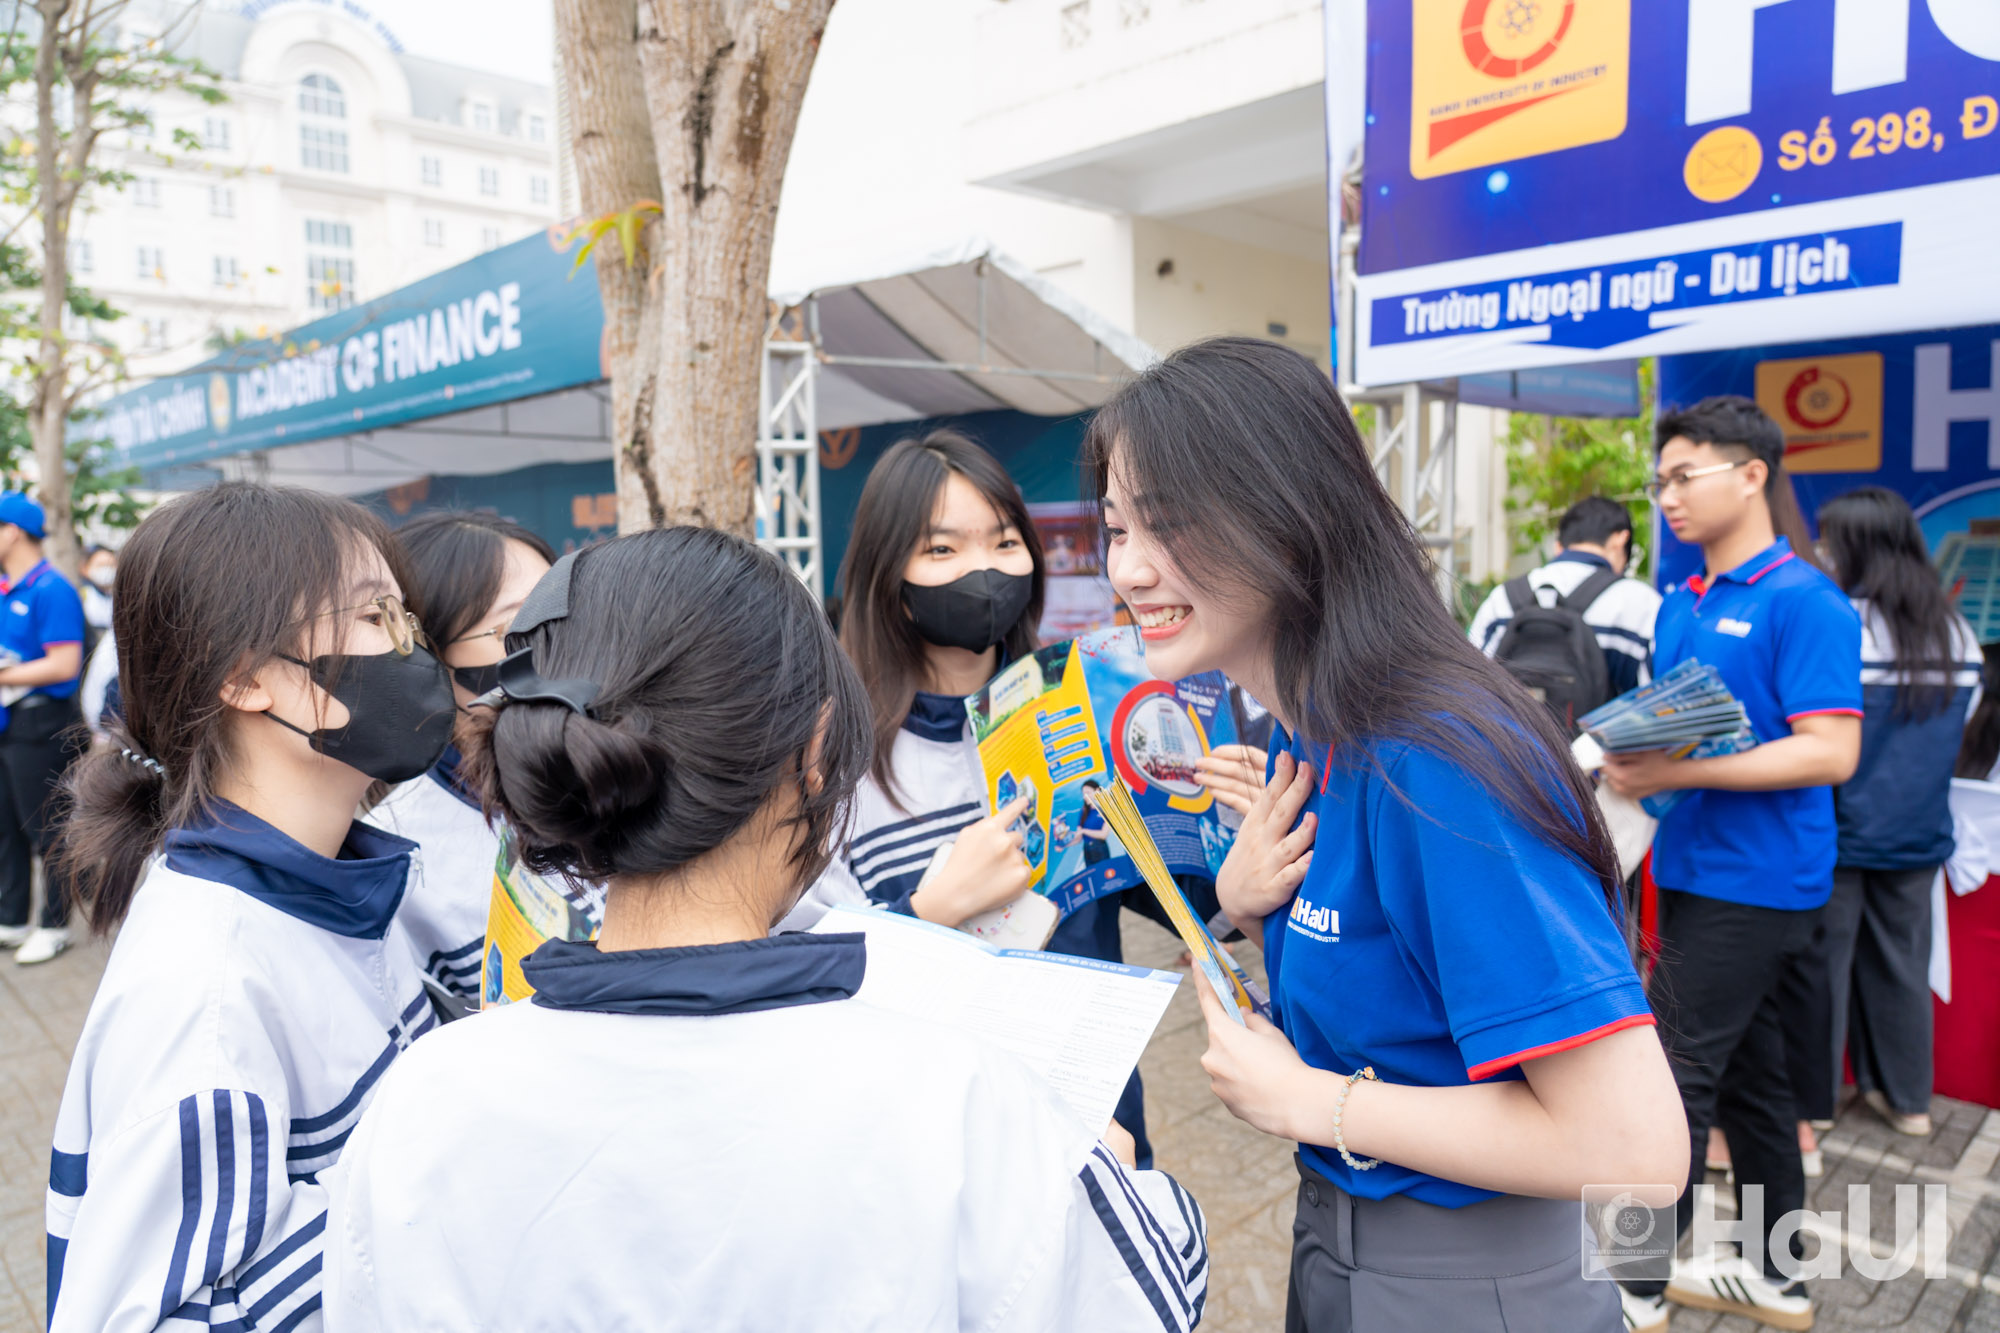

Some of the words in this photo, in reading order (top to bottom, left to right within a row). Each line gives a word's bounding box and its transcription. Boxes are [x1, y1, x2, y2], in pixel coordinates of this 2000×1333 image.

[1777, 115, 1837, 172] Số
[1848, 107, 1945, 160] 298,
[1959, 95, 2000, 140] Đ
[1402, 290, 1501, 336] Trường
[1506, 270, 1602, 322] Ngoại
[1608, 259, 1679, 312] ngữ
[1709, 251, 1761, 297] Du
[1770, 236, 1850, 297] lịch
[235, 343, 341, 421] ACADEMY
[341, 330, 379, 393] OF
[381, 281, 522, 384] FINANCE
[1296, 898, 1341, 934] HaUI
